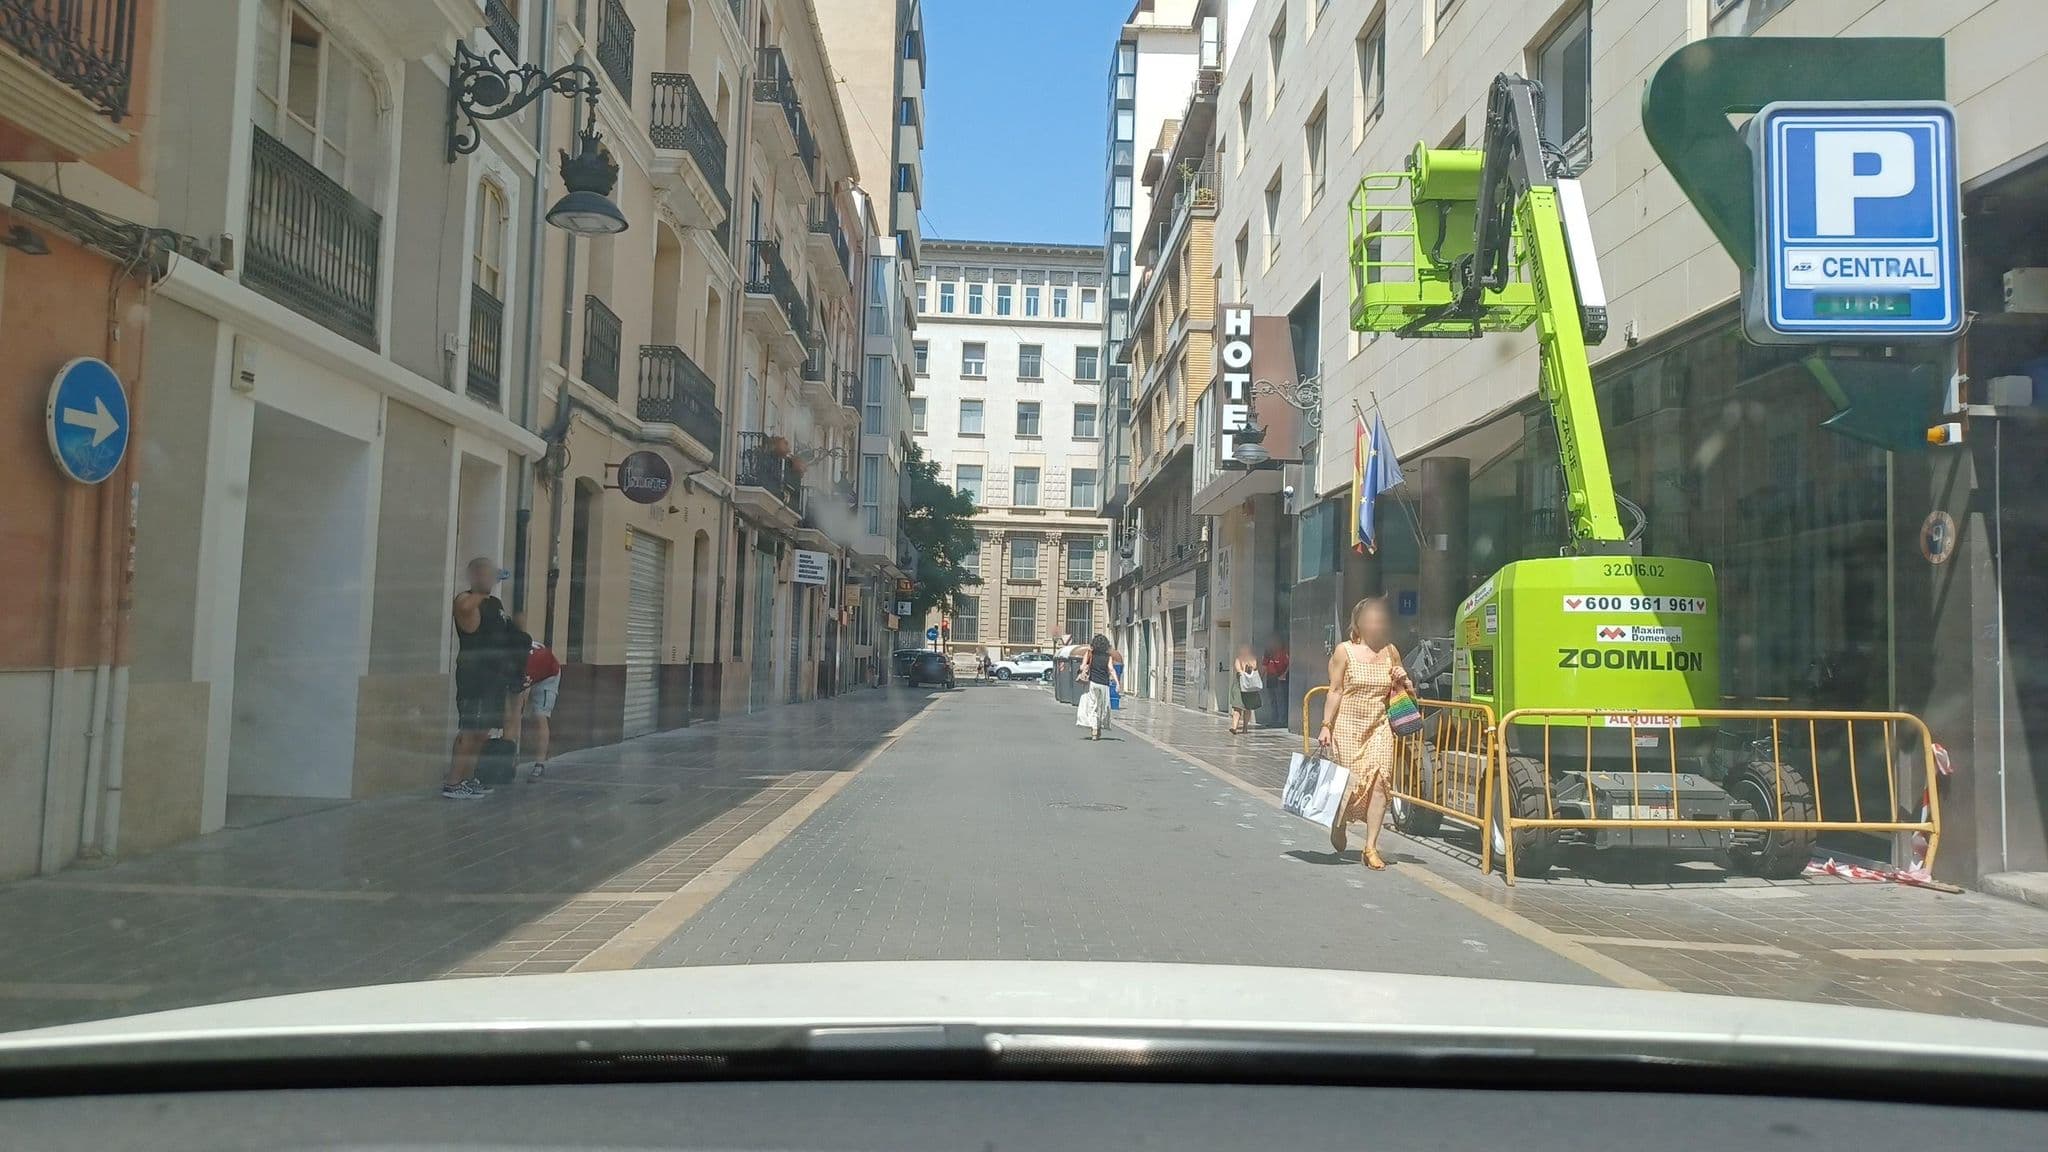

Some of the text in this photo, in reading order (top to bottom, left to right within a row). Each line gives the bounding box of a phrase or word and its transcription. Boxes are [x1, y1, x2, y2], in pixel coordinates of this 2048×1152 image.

[1814, 130, 1916, 237] P
[1822, 256, 1934, 278] CENTRAL
[1221, 308, 1253, 461] HOTEL
[1603, 563, 1665, 578] 32.016.02
[1585, 597, 1694, 612] 600 961 961
[1631, 626, 1665, 635] Maxim
[1631, 633, 1682, 643] Domenech
[1558, 648, 1703, 672] ZOOMLION
